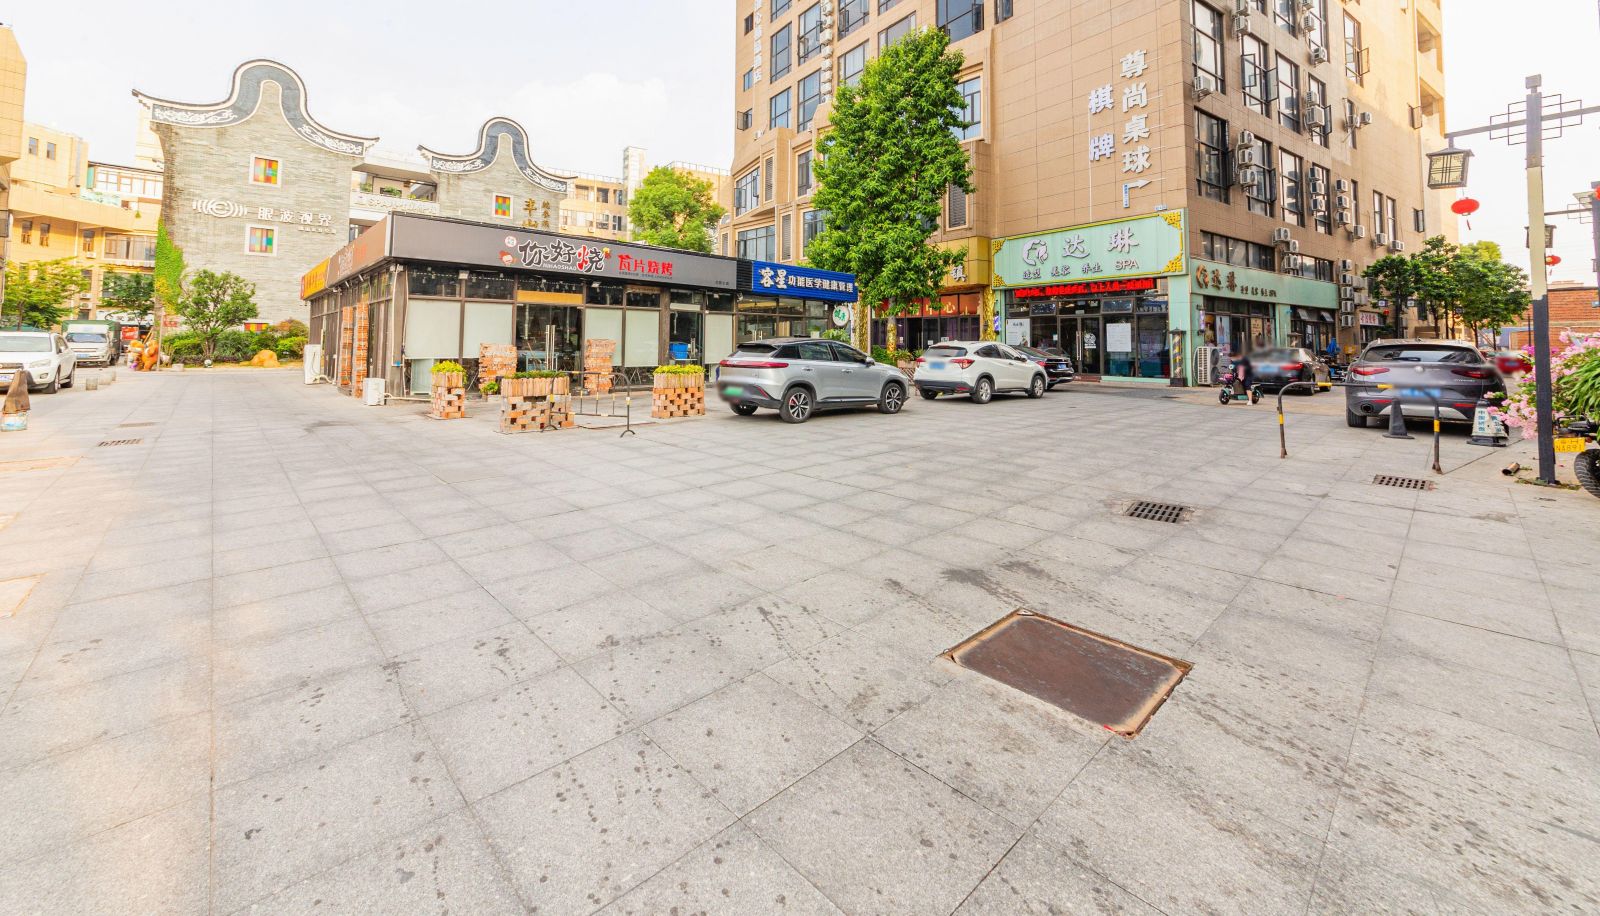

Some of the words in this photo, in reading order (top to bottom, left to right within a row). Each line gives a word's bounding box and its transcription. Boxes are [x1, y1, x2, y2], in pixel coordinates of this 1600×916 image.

[1088, 83, 1115, 162] 棋牌
[1120, 49, 1152, 173] 尊尚桌球
[257, 206, 332, 227] 眼波视界
[517, 238, 605, 274] 你好烧
[1062, 227, 1140, 259] 达琳
[617, 254, 673, 277] 瓦片烧烤
[758, 266, 788, 290] 容星
[787, 274, 854, 293] 功能医学健康管理
[1081, 261, 1103, 274] 养生
[1114, 257, 1140, 271] SPA
